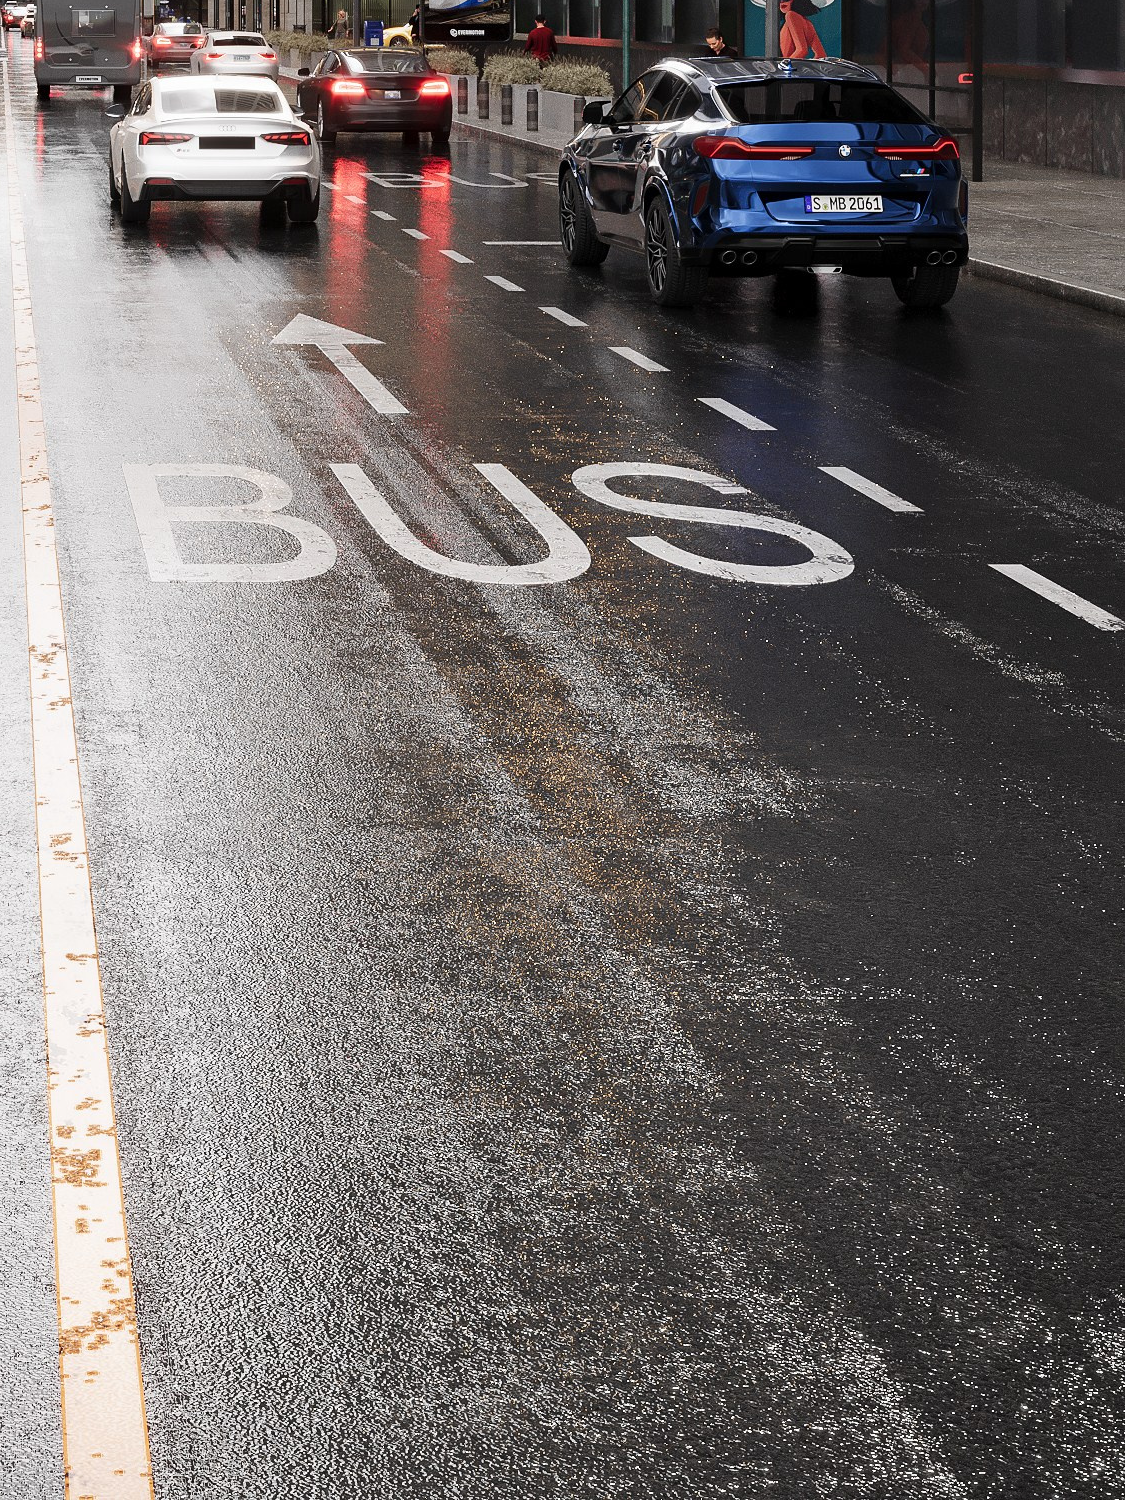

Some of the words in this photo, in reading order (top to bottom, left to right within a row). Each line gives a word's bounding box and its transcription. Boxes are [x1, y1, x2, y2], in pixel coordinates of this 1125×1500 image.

[813, 197, 821, 210] S
[830, 197, 846, 210] MB
[849, 197, 881, 210] 2061
[123, 461, 855, 586] BUS
